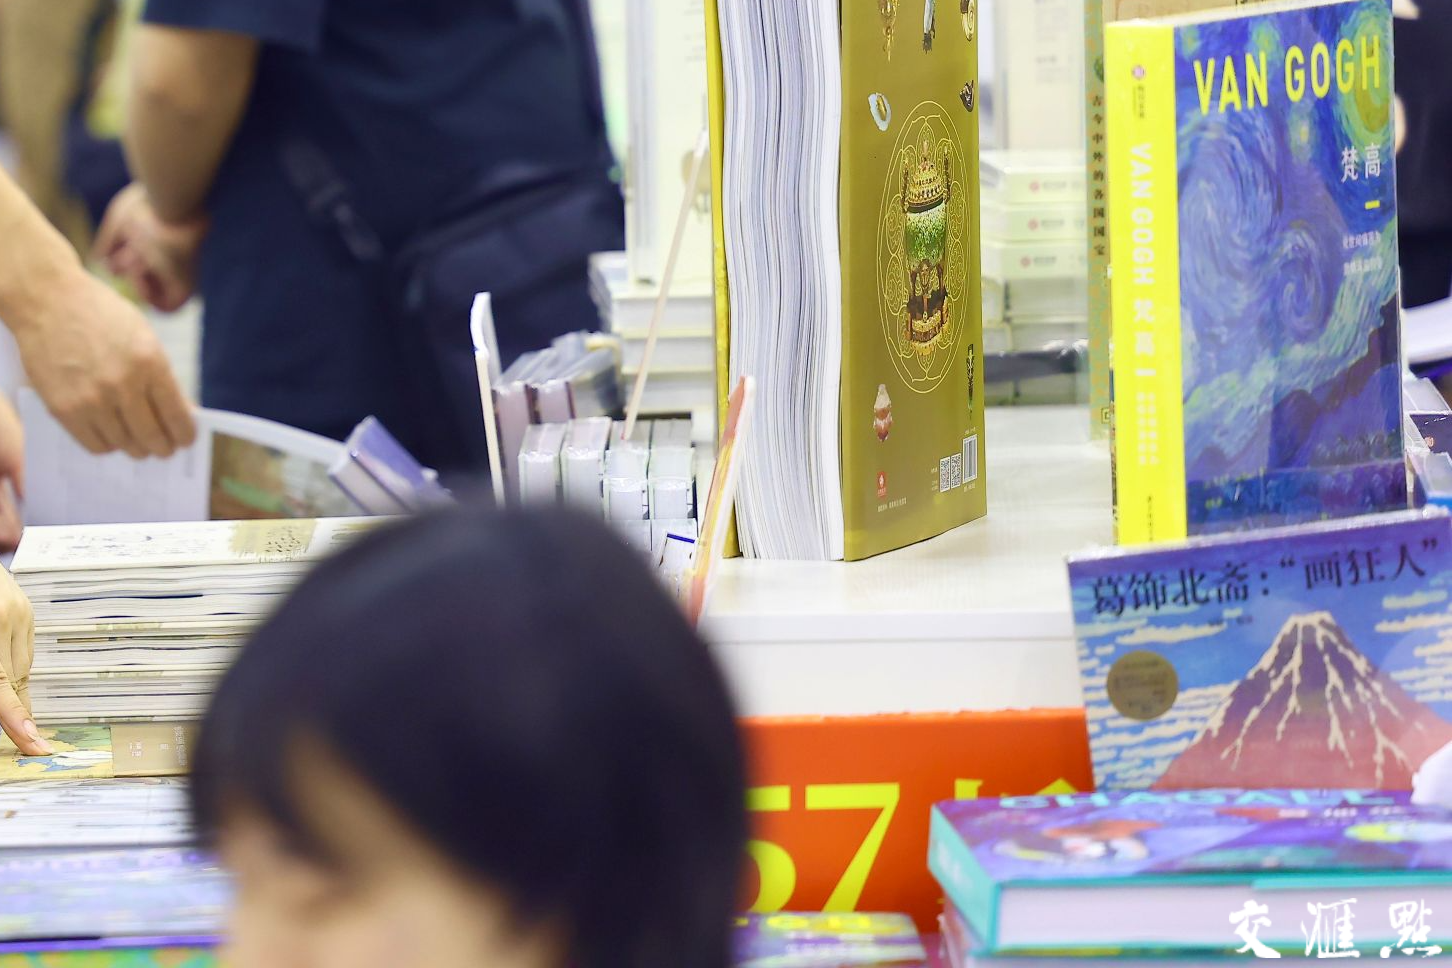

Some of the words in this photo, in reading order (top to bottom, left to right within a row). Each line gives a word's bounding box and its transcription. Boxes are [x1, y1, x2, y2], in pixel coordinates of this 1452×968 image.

[1193, 50, 1268, 116] VAN
[1285, 35, 1381, 102] GOGH
[1130, 143, 1153, 199] VAN
[1341, 142, 1382, 183] 梵高
[1131, 207, 1155, 286] GOGH
